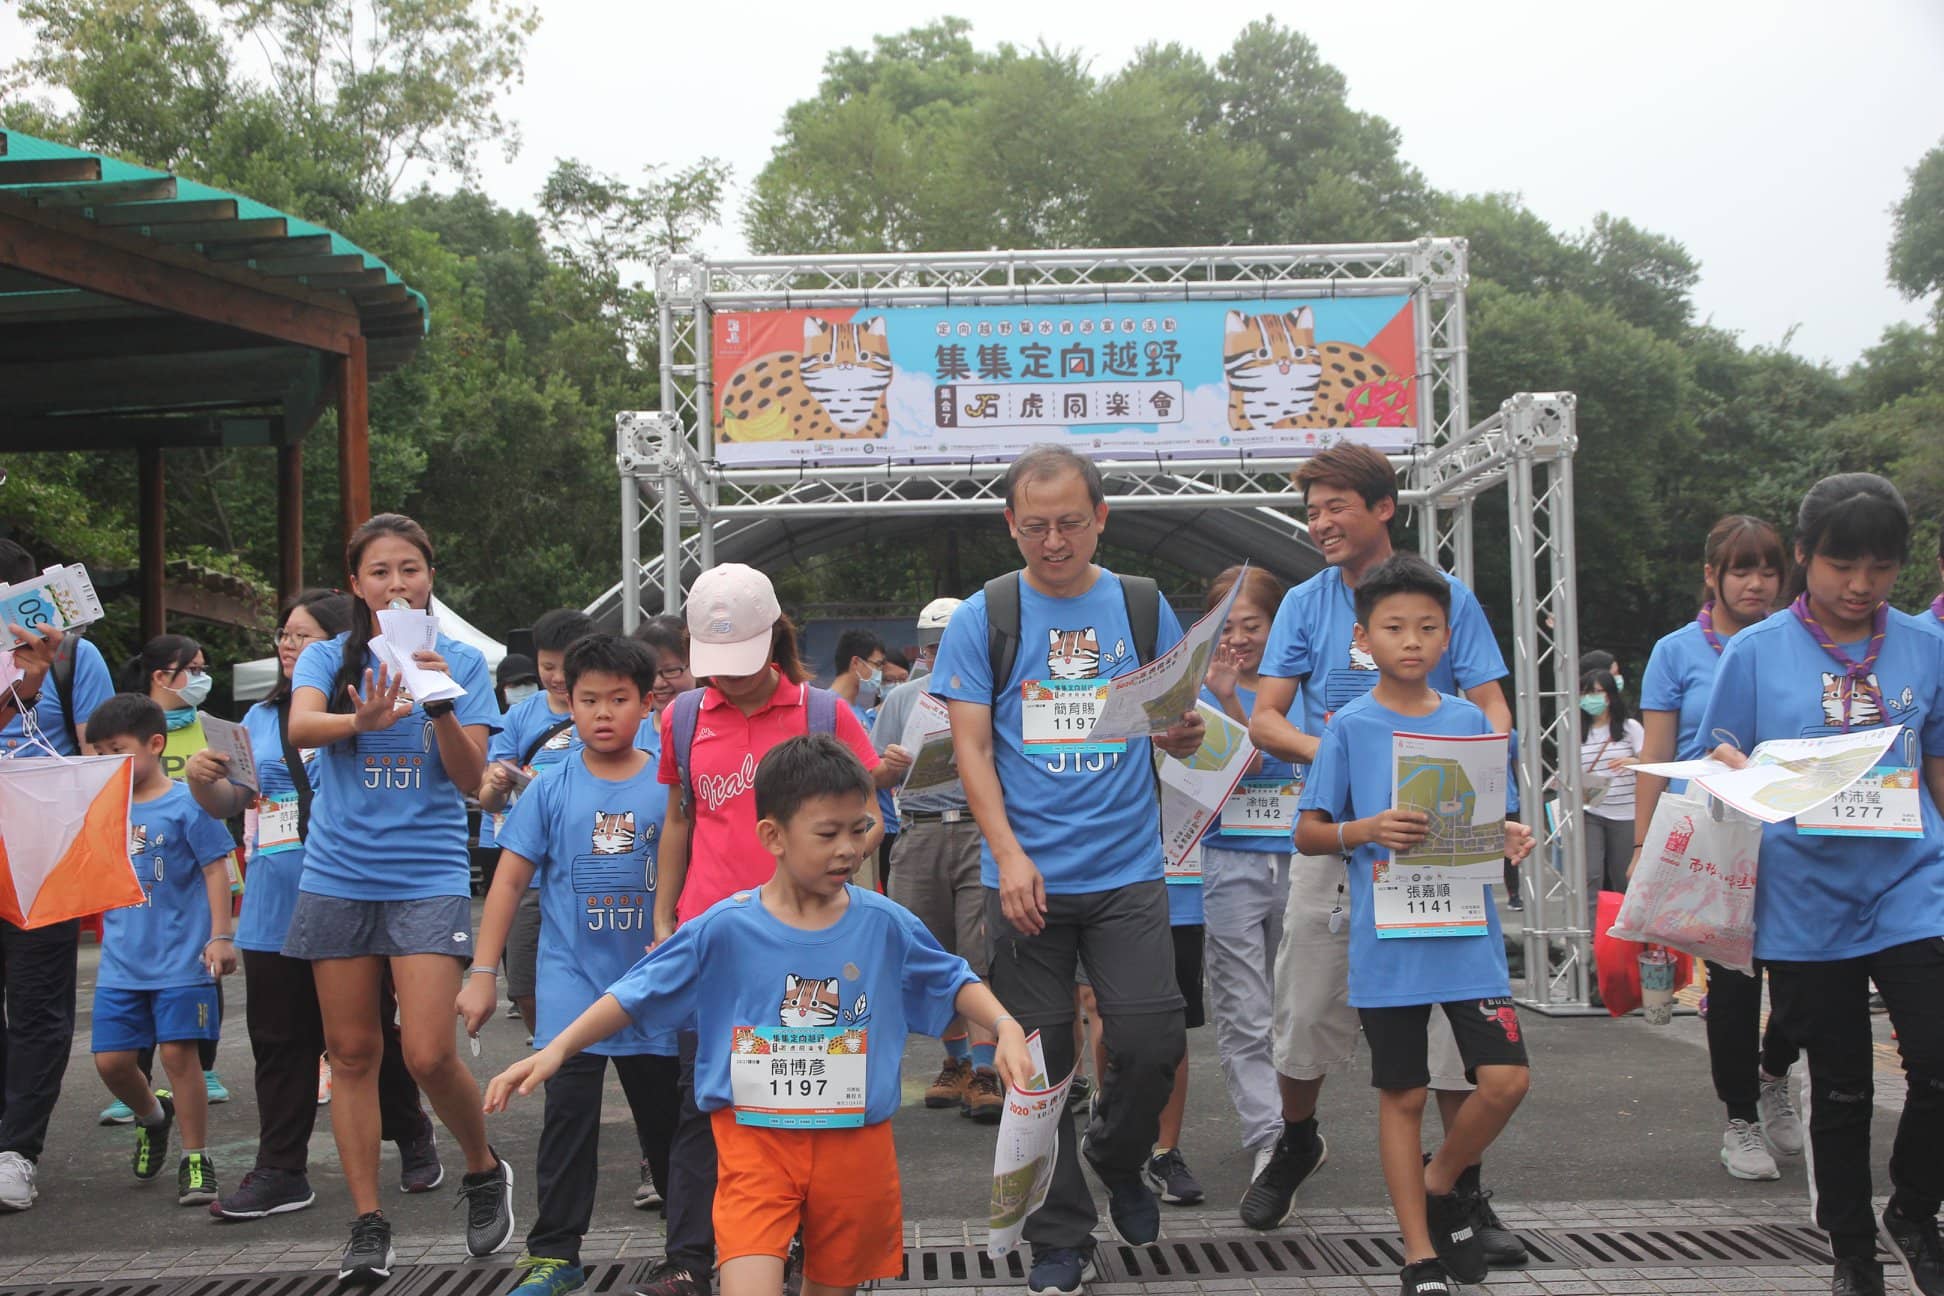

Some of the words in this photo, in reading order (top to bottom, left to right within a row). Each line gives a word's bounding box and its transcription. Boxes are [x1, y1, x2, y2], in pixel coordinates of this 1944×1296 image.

[935, 340, 1181, 379] 集集定向越野
[1054, 718, 1096, 730] 1197
[1246, 809, 1280, 818] 1142
[1832, 806, 1883, 818] 1277
[1407, 883, 1450, 898] 張嘉順
[1407, 900, 1451, 913] 1141
[771, 1058, 826, 1076] 簡博彥
[769, 1080, 828, 1096] 1197
